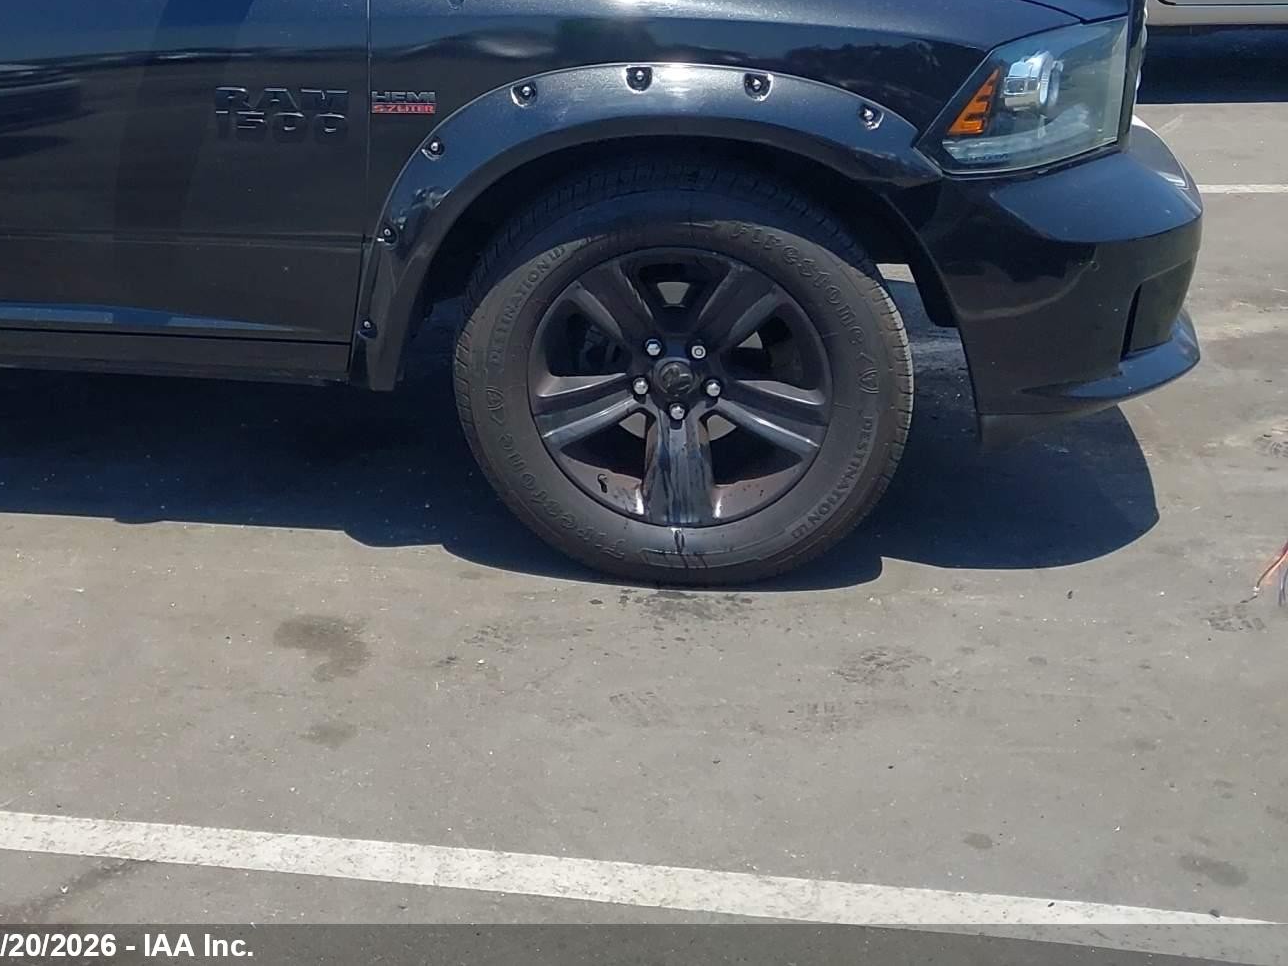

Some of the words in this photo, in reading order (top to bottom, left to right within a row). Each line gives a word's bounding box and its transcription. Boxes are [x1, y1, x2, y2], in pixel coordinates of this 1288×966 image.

[214, 86, 350, 111] RAM
[371, 91, 436, 103] HEMI
[214, 109, 350, 143] 1500
